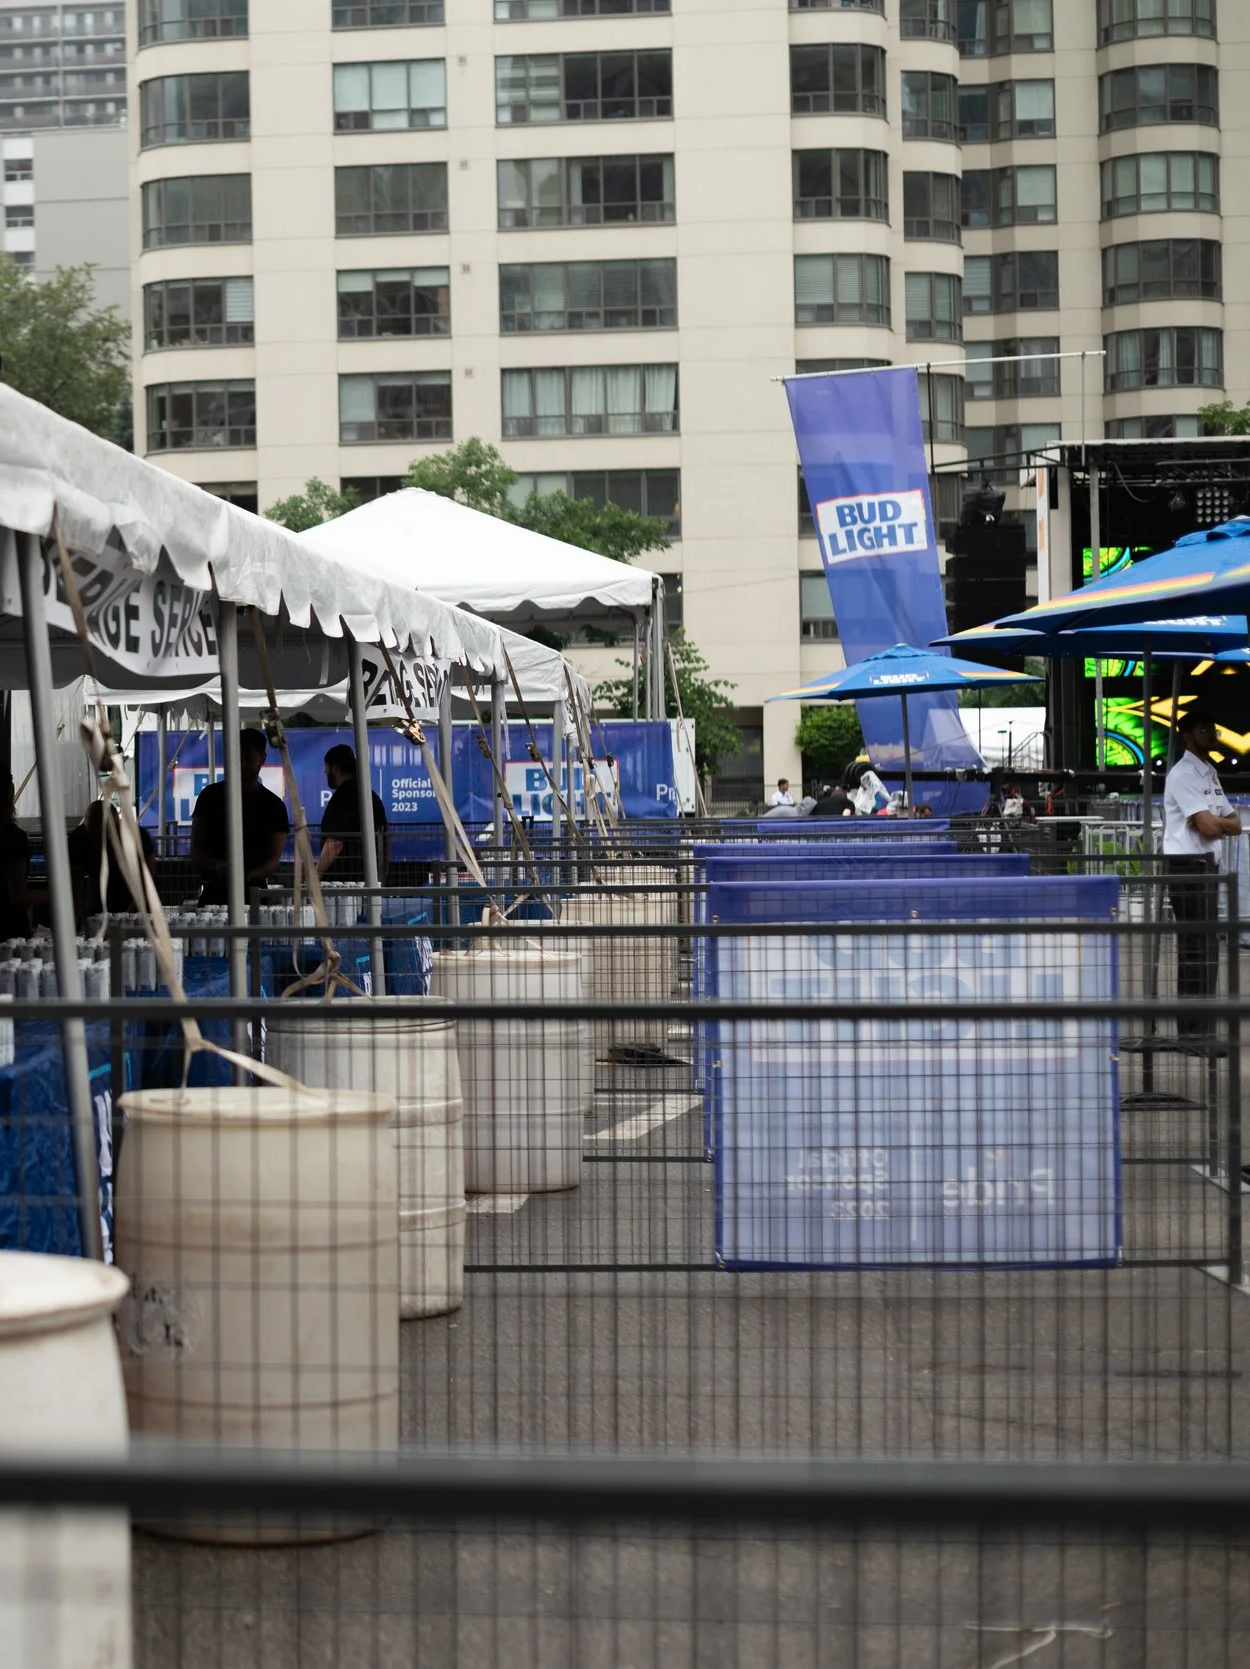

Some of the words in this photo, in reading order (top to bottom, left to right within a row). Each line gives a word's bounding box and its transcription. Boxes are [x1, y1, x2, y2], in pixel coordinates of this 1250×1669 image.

[835, 499, 902, 528] BUD
[828, 522, 918, 557] LIGHT
[391, 778, 431, 789] Official
[391, 802, 418, 812] 2023
